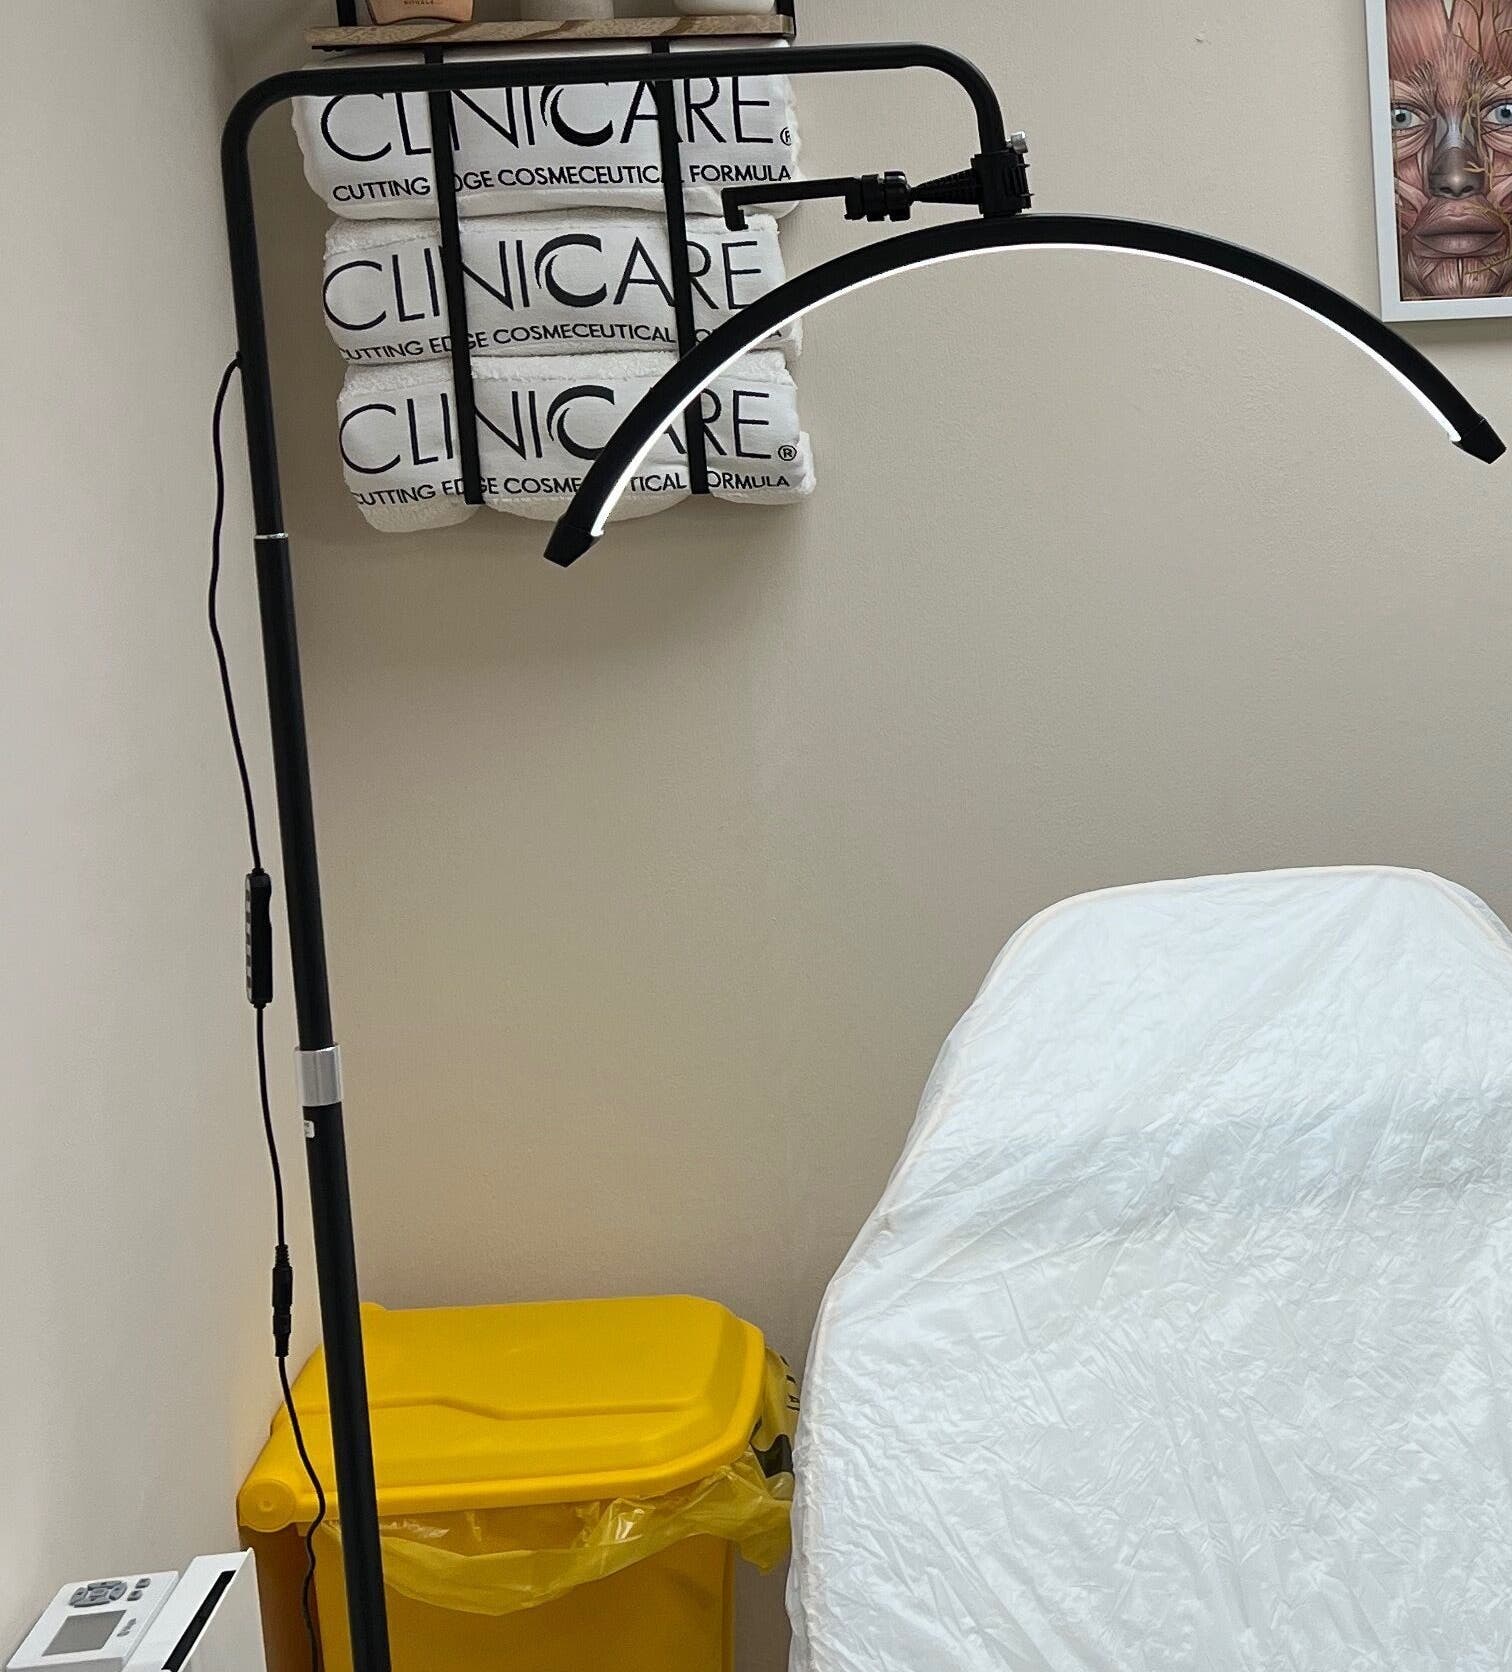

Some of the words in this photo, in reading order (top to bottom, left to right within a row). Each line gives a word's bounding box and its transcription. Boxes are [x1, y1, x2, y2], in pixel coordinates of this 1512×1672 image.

[321, 76, 772, 162] CLNICARE
[333, 176, 431, 202] CUTTING
[453, 170, 495, 193] DGE
[498, 164, 684, 186] COSMECEUTIC
[690, 164, 792, 183] FORMULA
[493, 322, 676, 344] COSMECEUTICAL
[339, 384, 772, 475] CLINICRE
[503, 472, 688, 496] COSMETICAL
[706, 470, 790, 490] ORMULA
